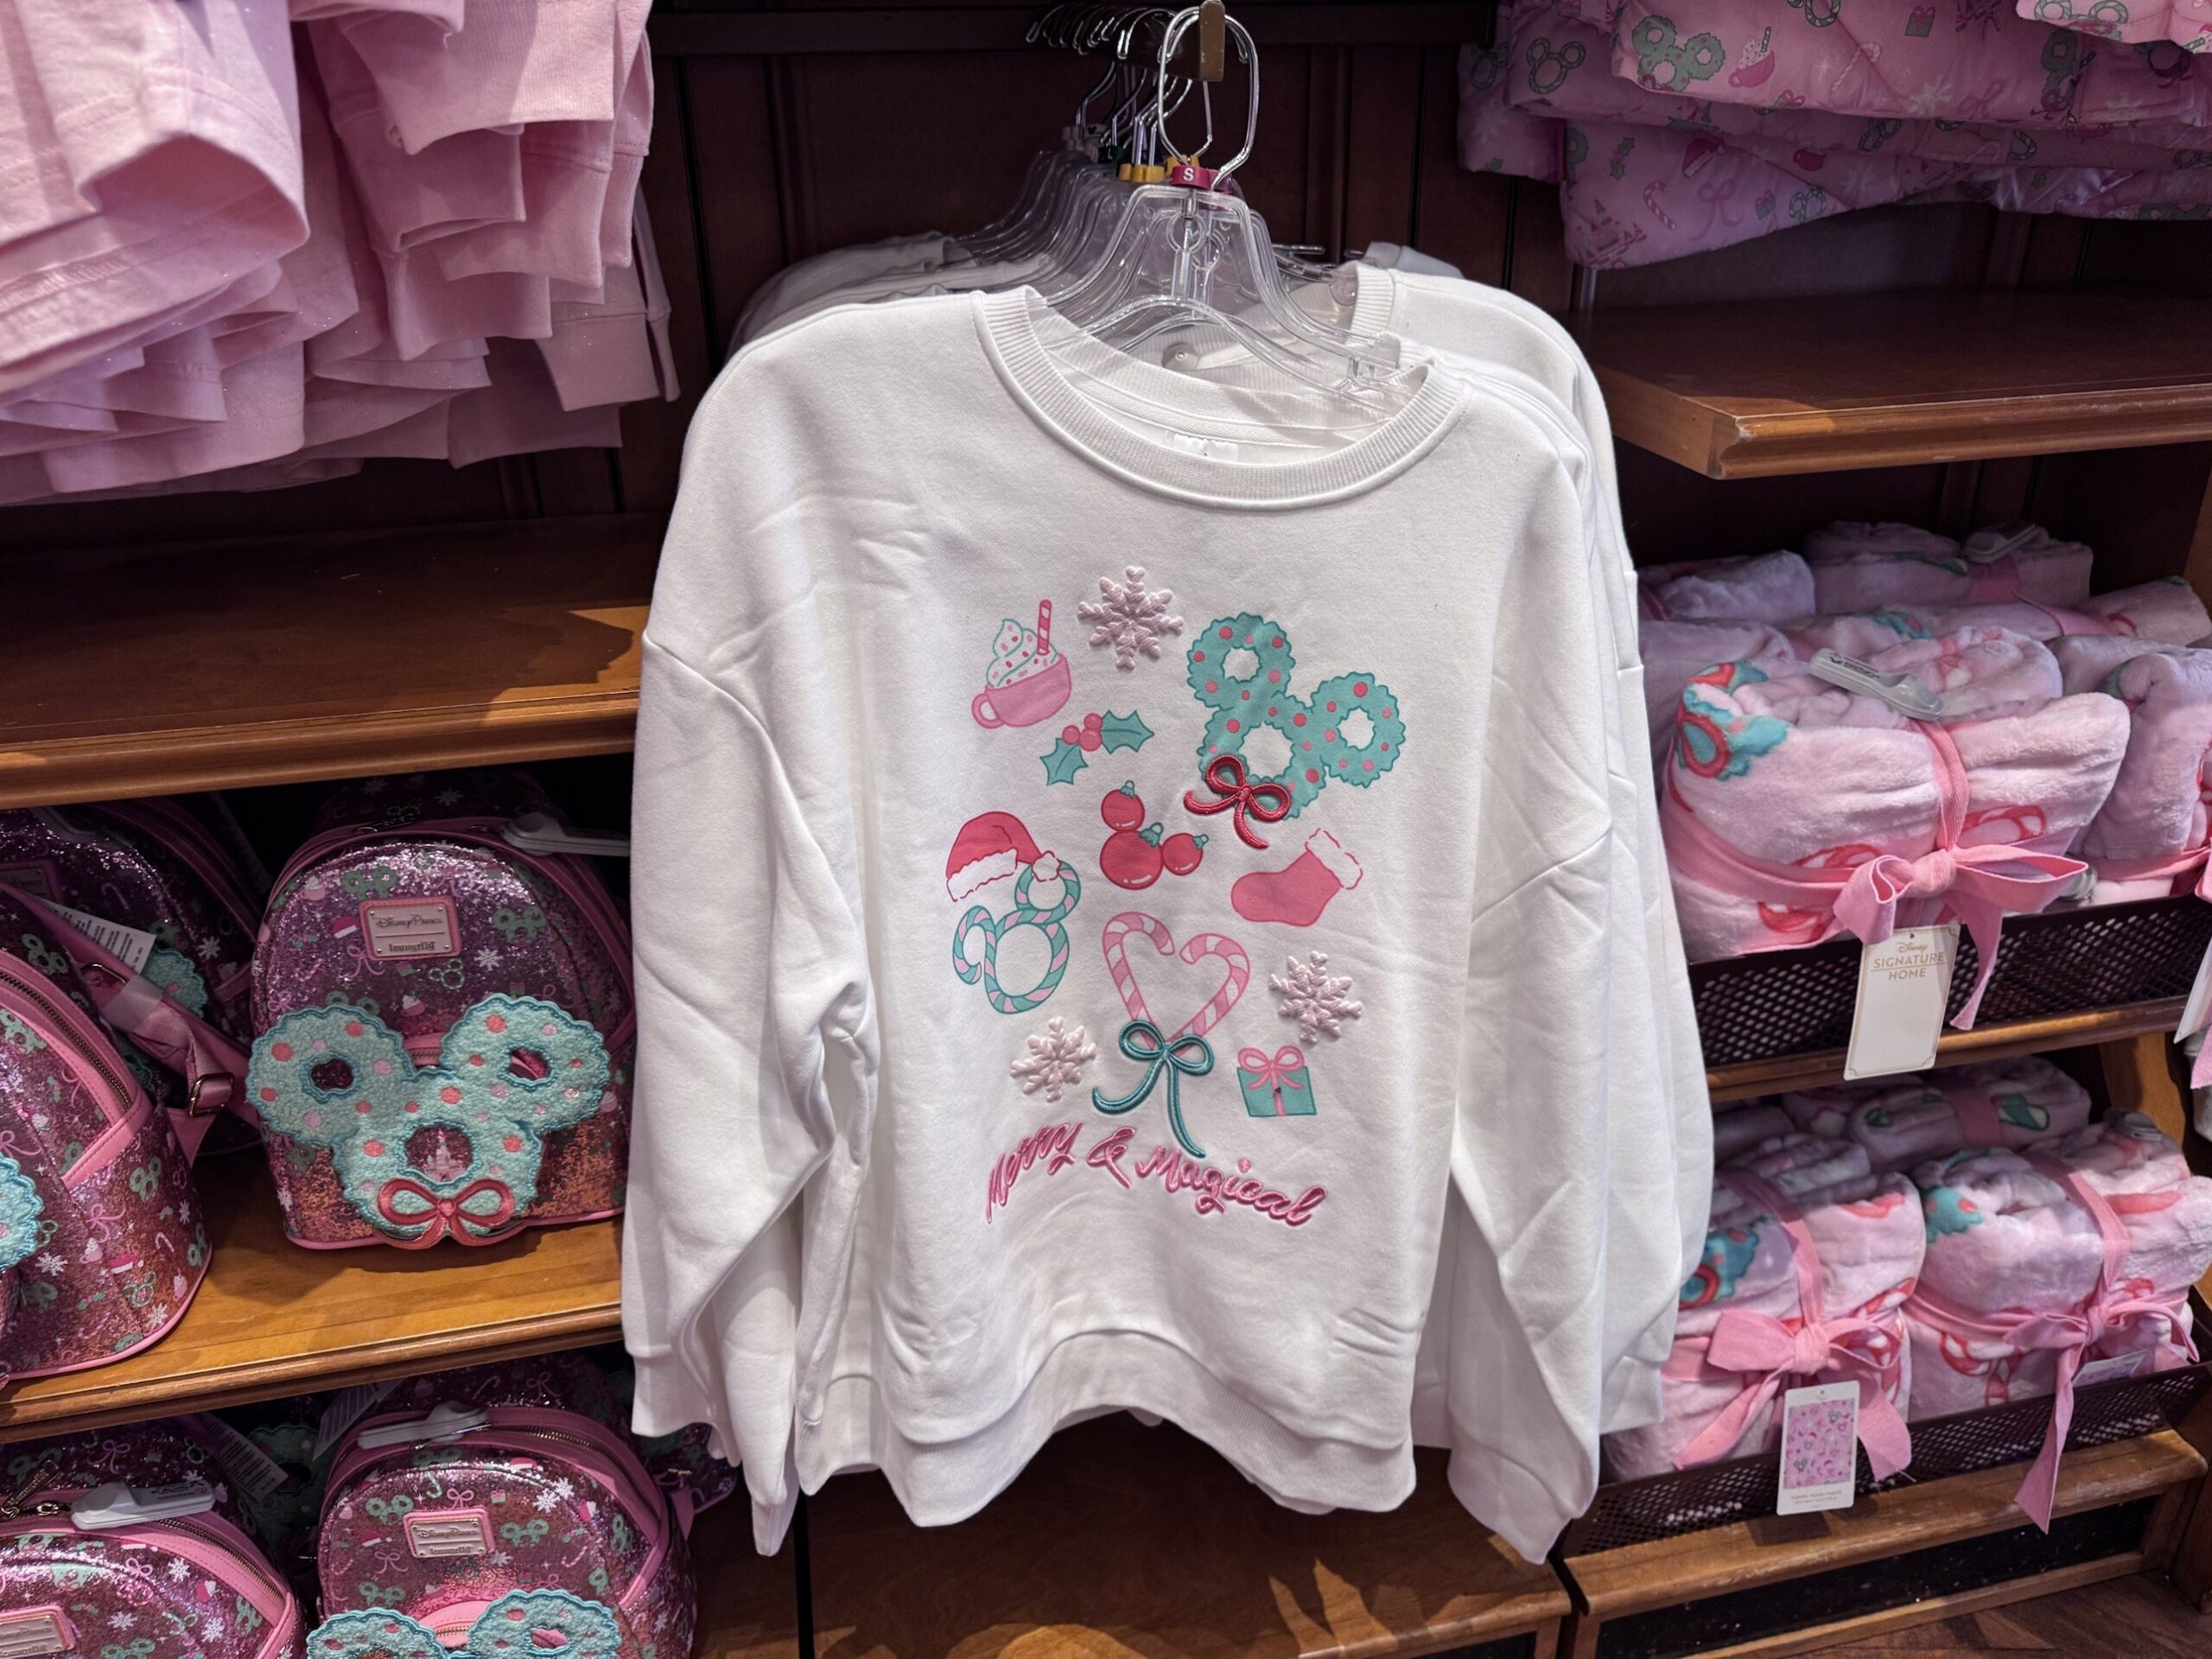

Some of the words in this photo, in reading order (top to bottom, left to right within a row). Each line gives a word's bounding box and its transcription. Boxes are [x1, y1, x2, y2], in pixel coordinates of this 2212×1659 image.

[1182, 168, 1194, 181] S
[1896, 941, 1928, 953] Disney
[1873, 951, 1945, 969] SIGNATURE
[1888, 967, 1927, 981] HOME
[1086, 1126, 1136, 1189] &
[1135, 1146, 1328, 1227] Magical
